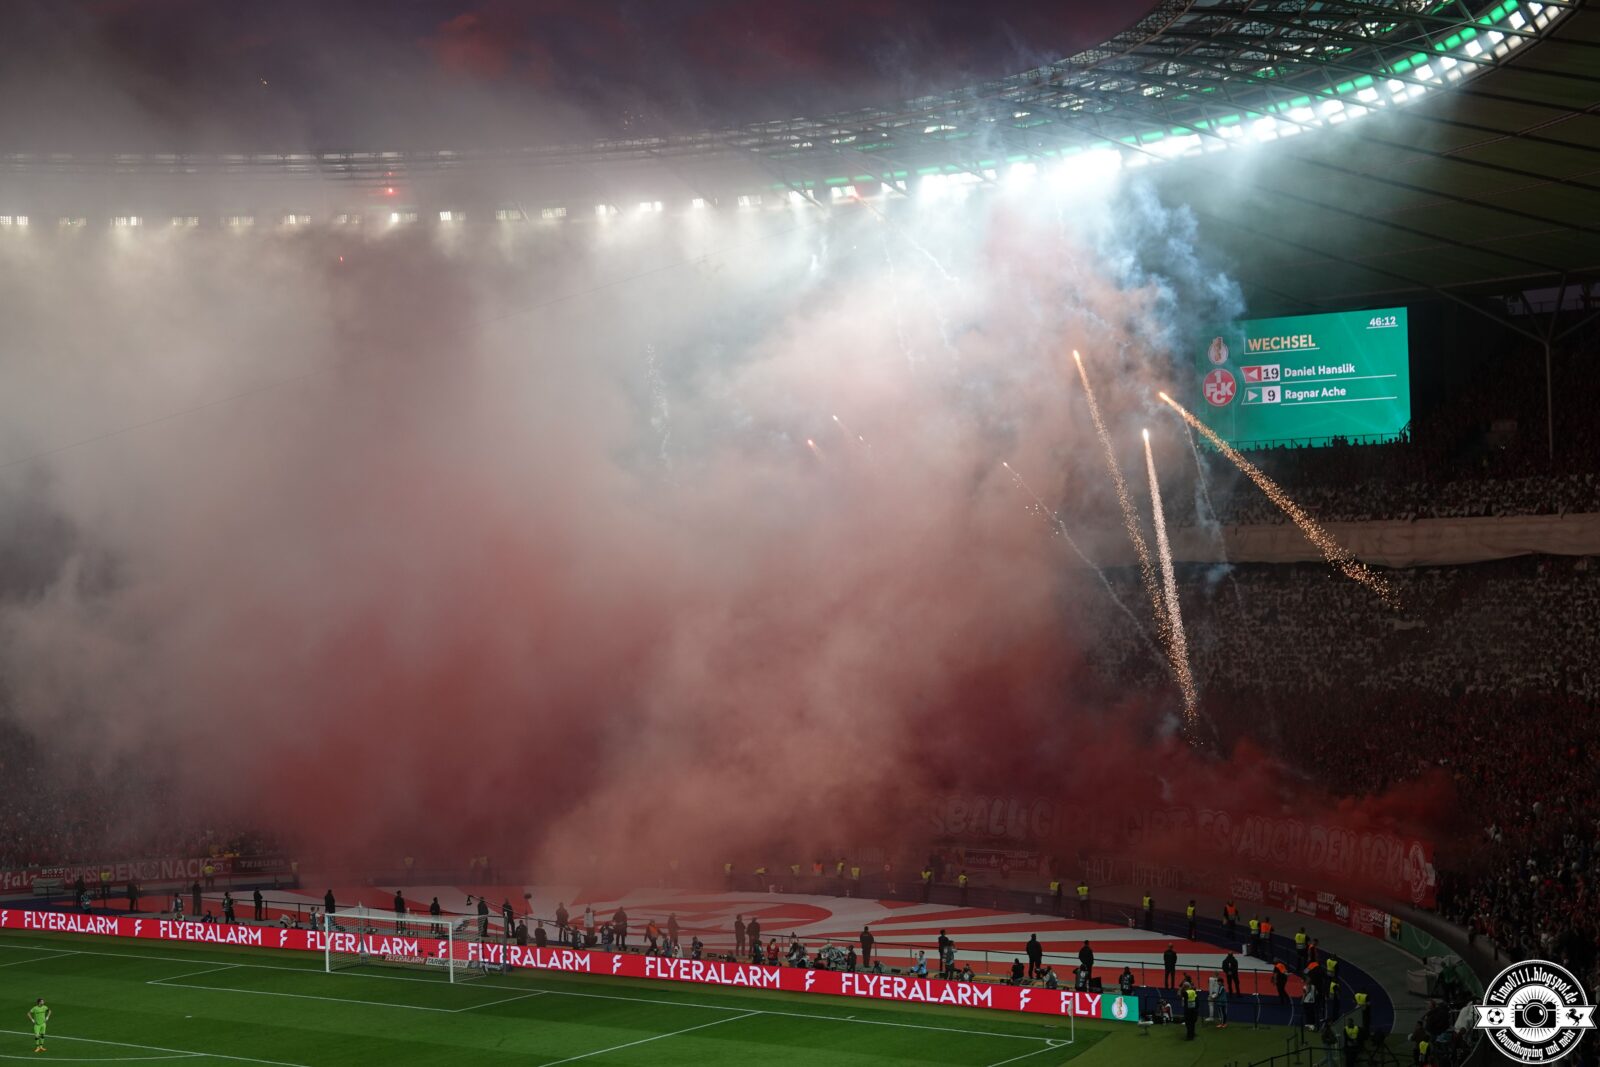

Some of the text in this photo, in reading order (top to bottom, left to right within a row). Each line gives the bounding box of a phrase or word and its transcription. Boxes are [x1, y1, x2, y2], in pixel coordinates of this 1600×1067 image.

[1369, 316, 1397, 327] 46:12
[1247, 334, 1316, 351] WECHSEL
[1263, 363, 1356, 381] 19 Daniel Hanslik
[1267, 387, 1347, 402] 9 Ragnar Ache
[24, 911, 119, 935] FLYERALARM
[159, 920, 262, 946] FLYERALARM
[306, 930, 418, 957] FLYERALARM
[467, 942, 591, 972] FLYERALARM
[645, 956, 780, 989] FLYERALARM
[841, 972, 992, 1007] FLYERALARM
[1060, 991, 1102, 1016] FLY
